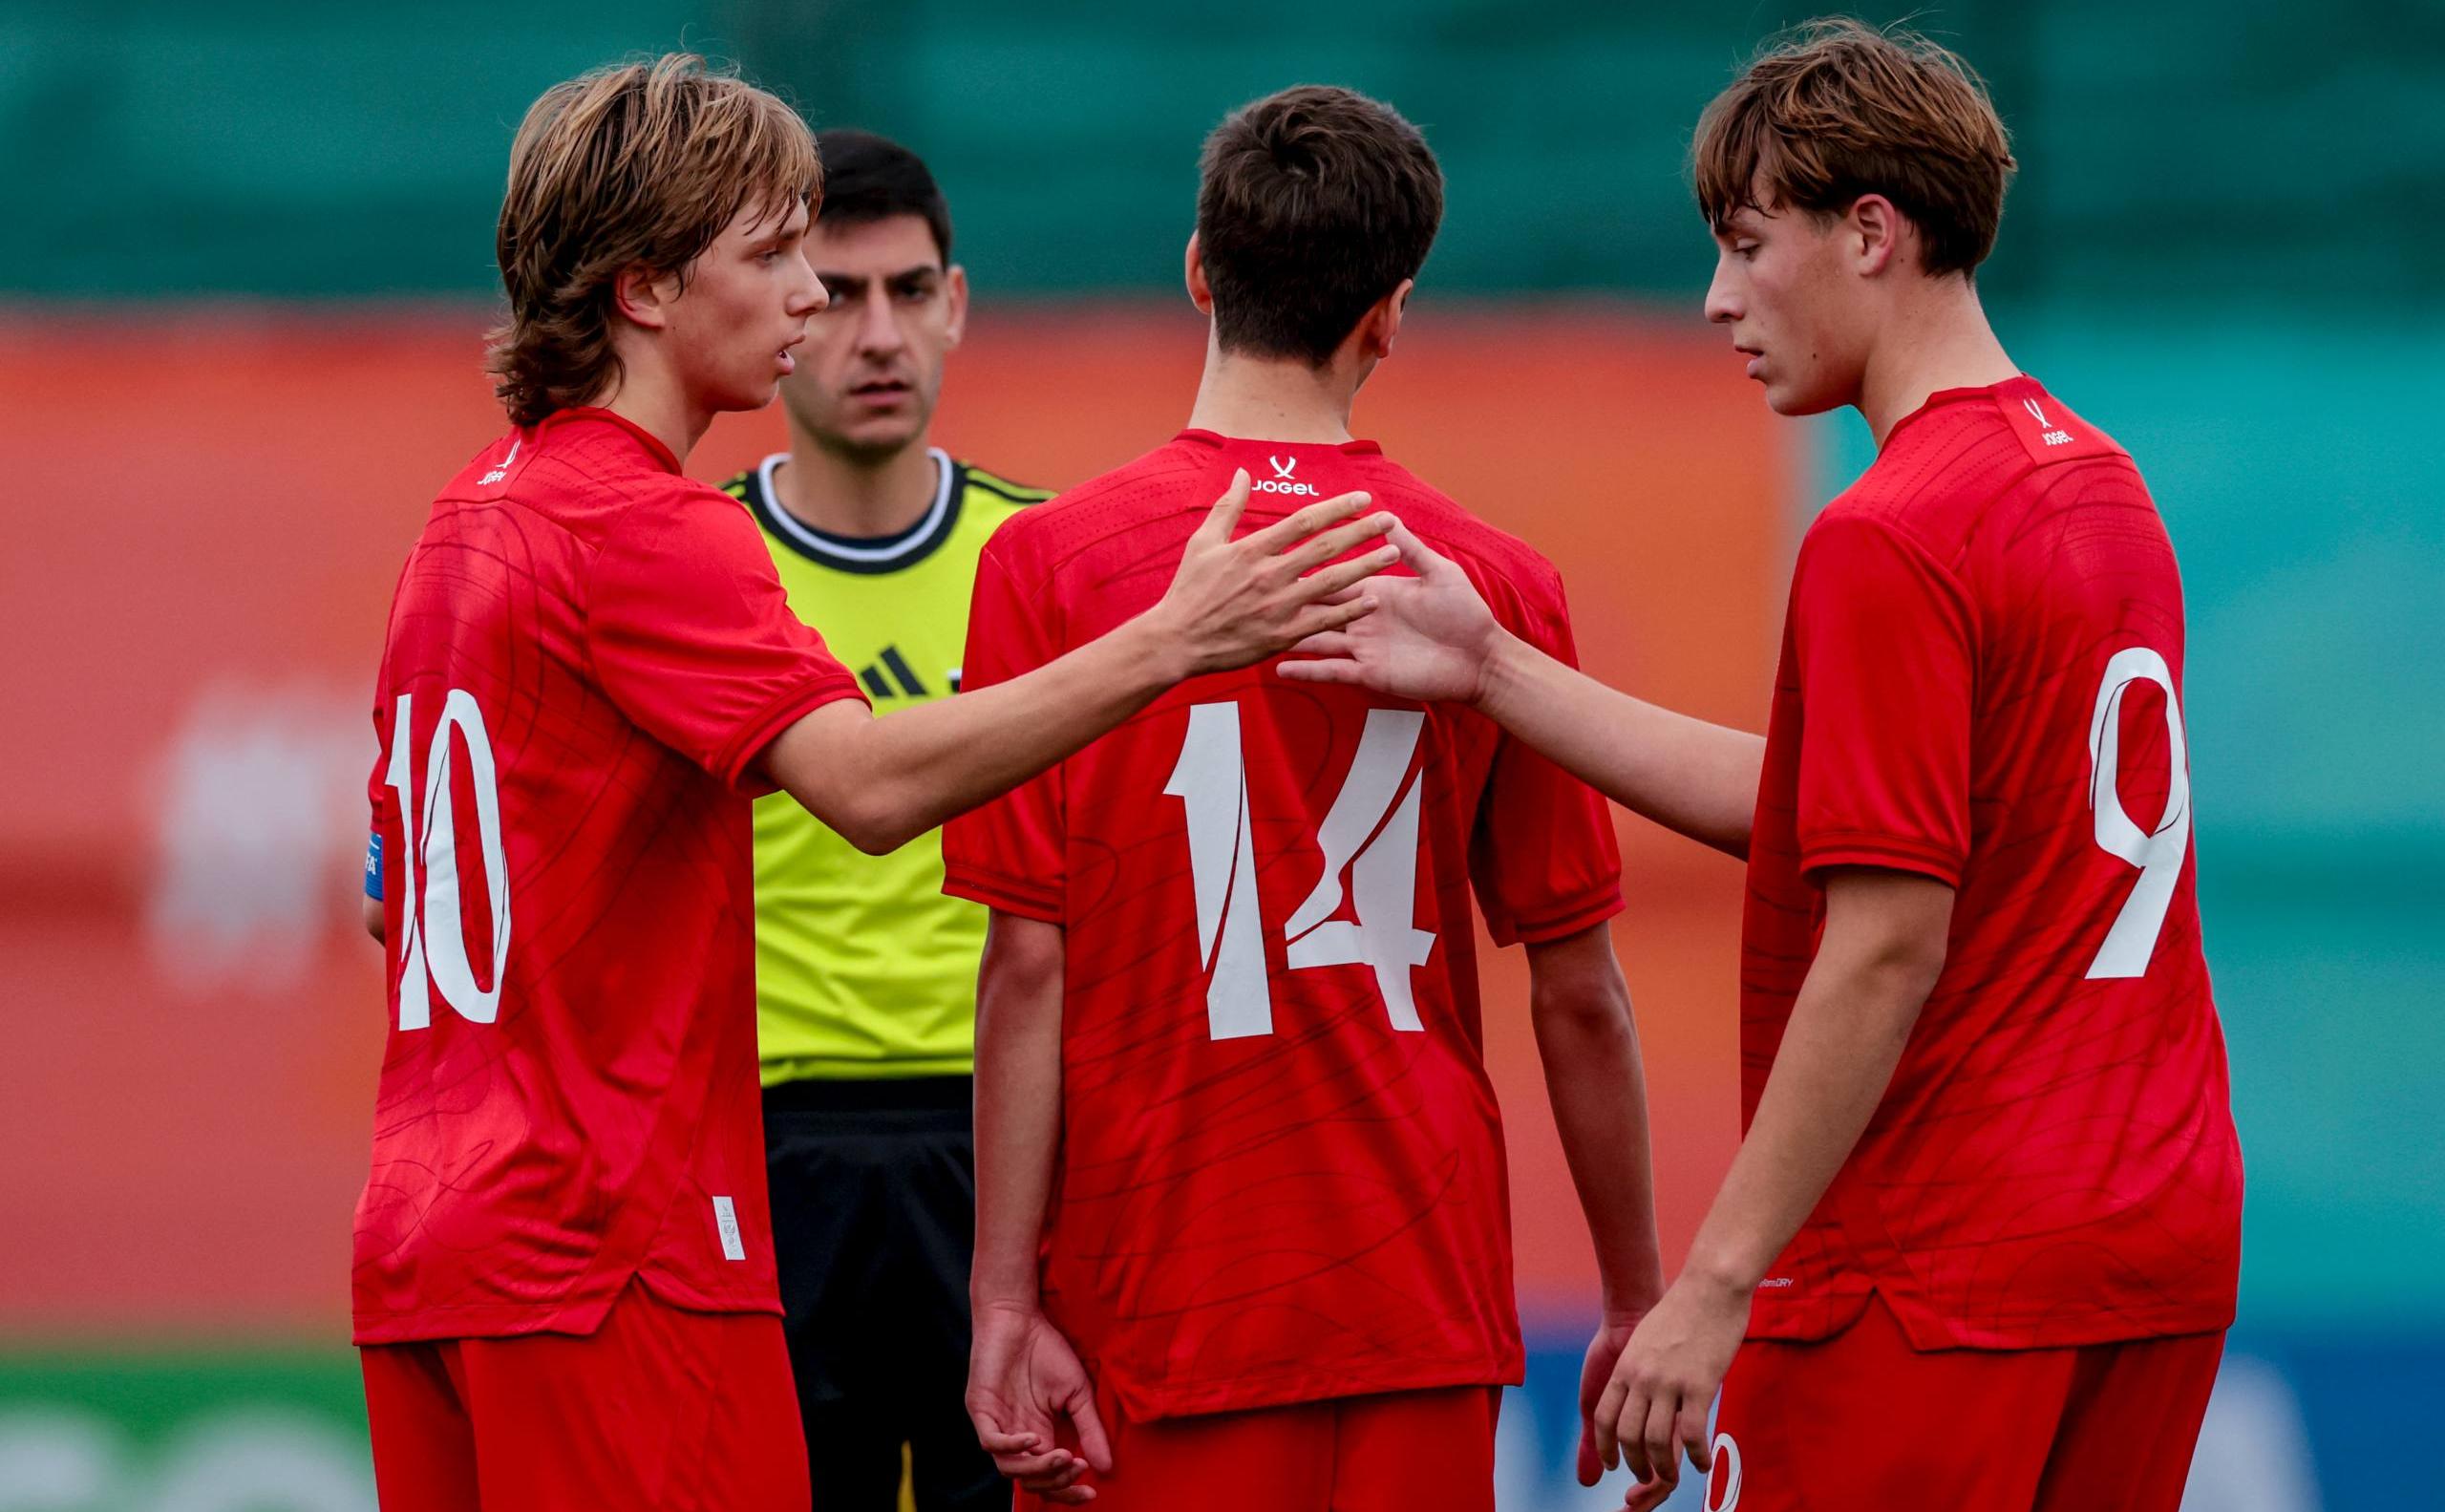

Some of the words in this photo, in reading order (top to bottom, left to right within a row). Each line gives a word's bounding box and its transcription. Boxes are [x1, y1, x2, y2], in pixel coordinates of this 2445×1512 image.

[384, 689, 512, 1032] 10
[1162, 700, 1437, 1042] 14
[2084, 647, 2191, 980] 9
